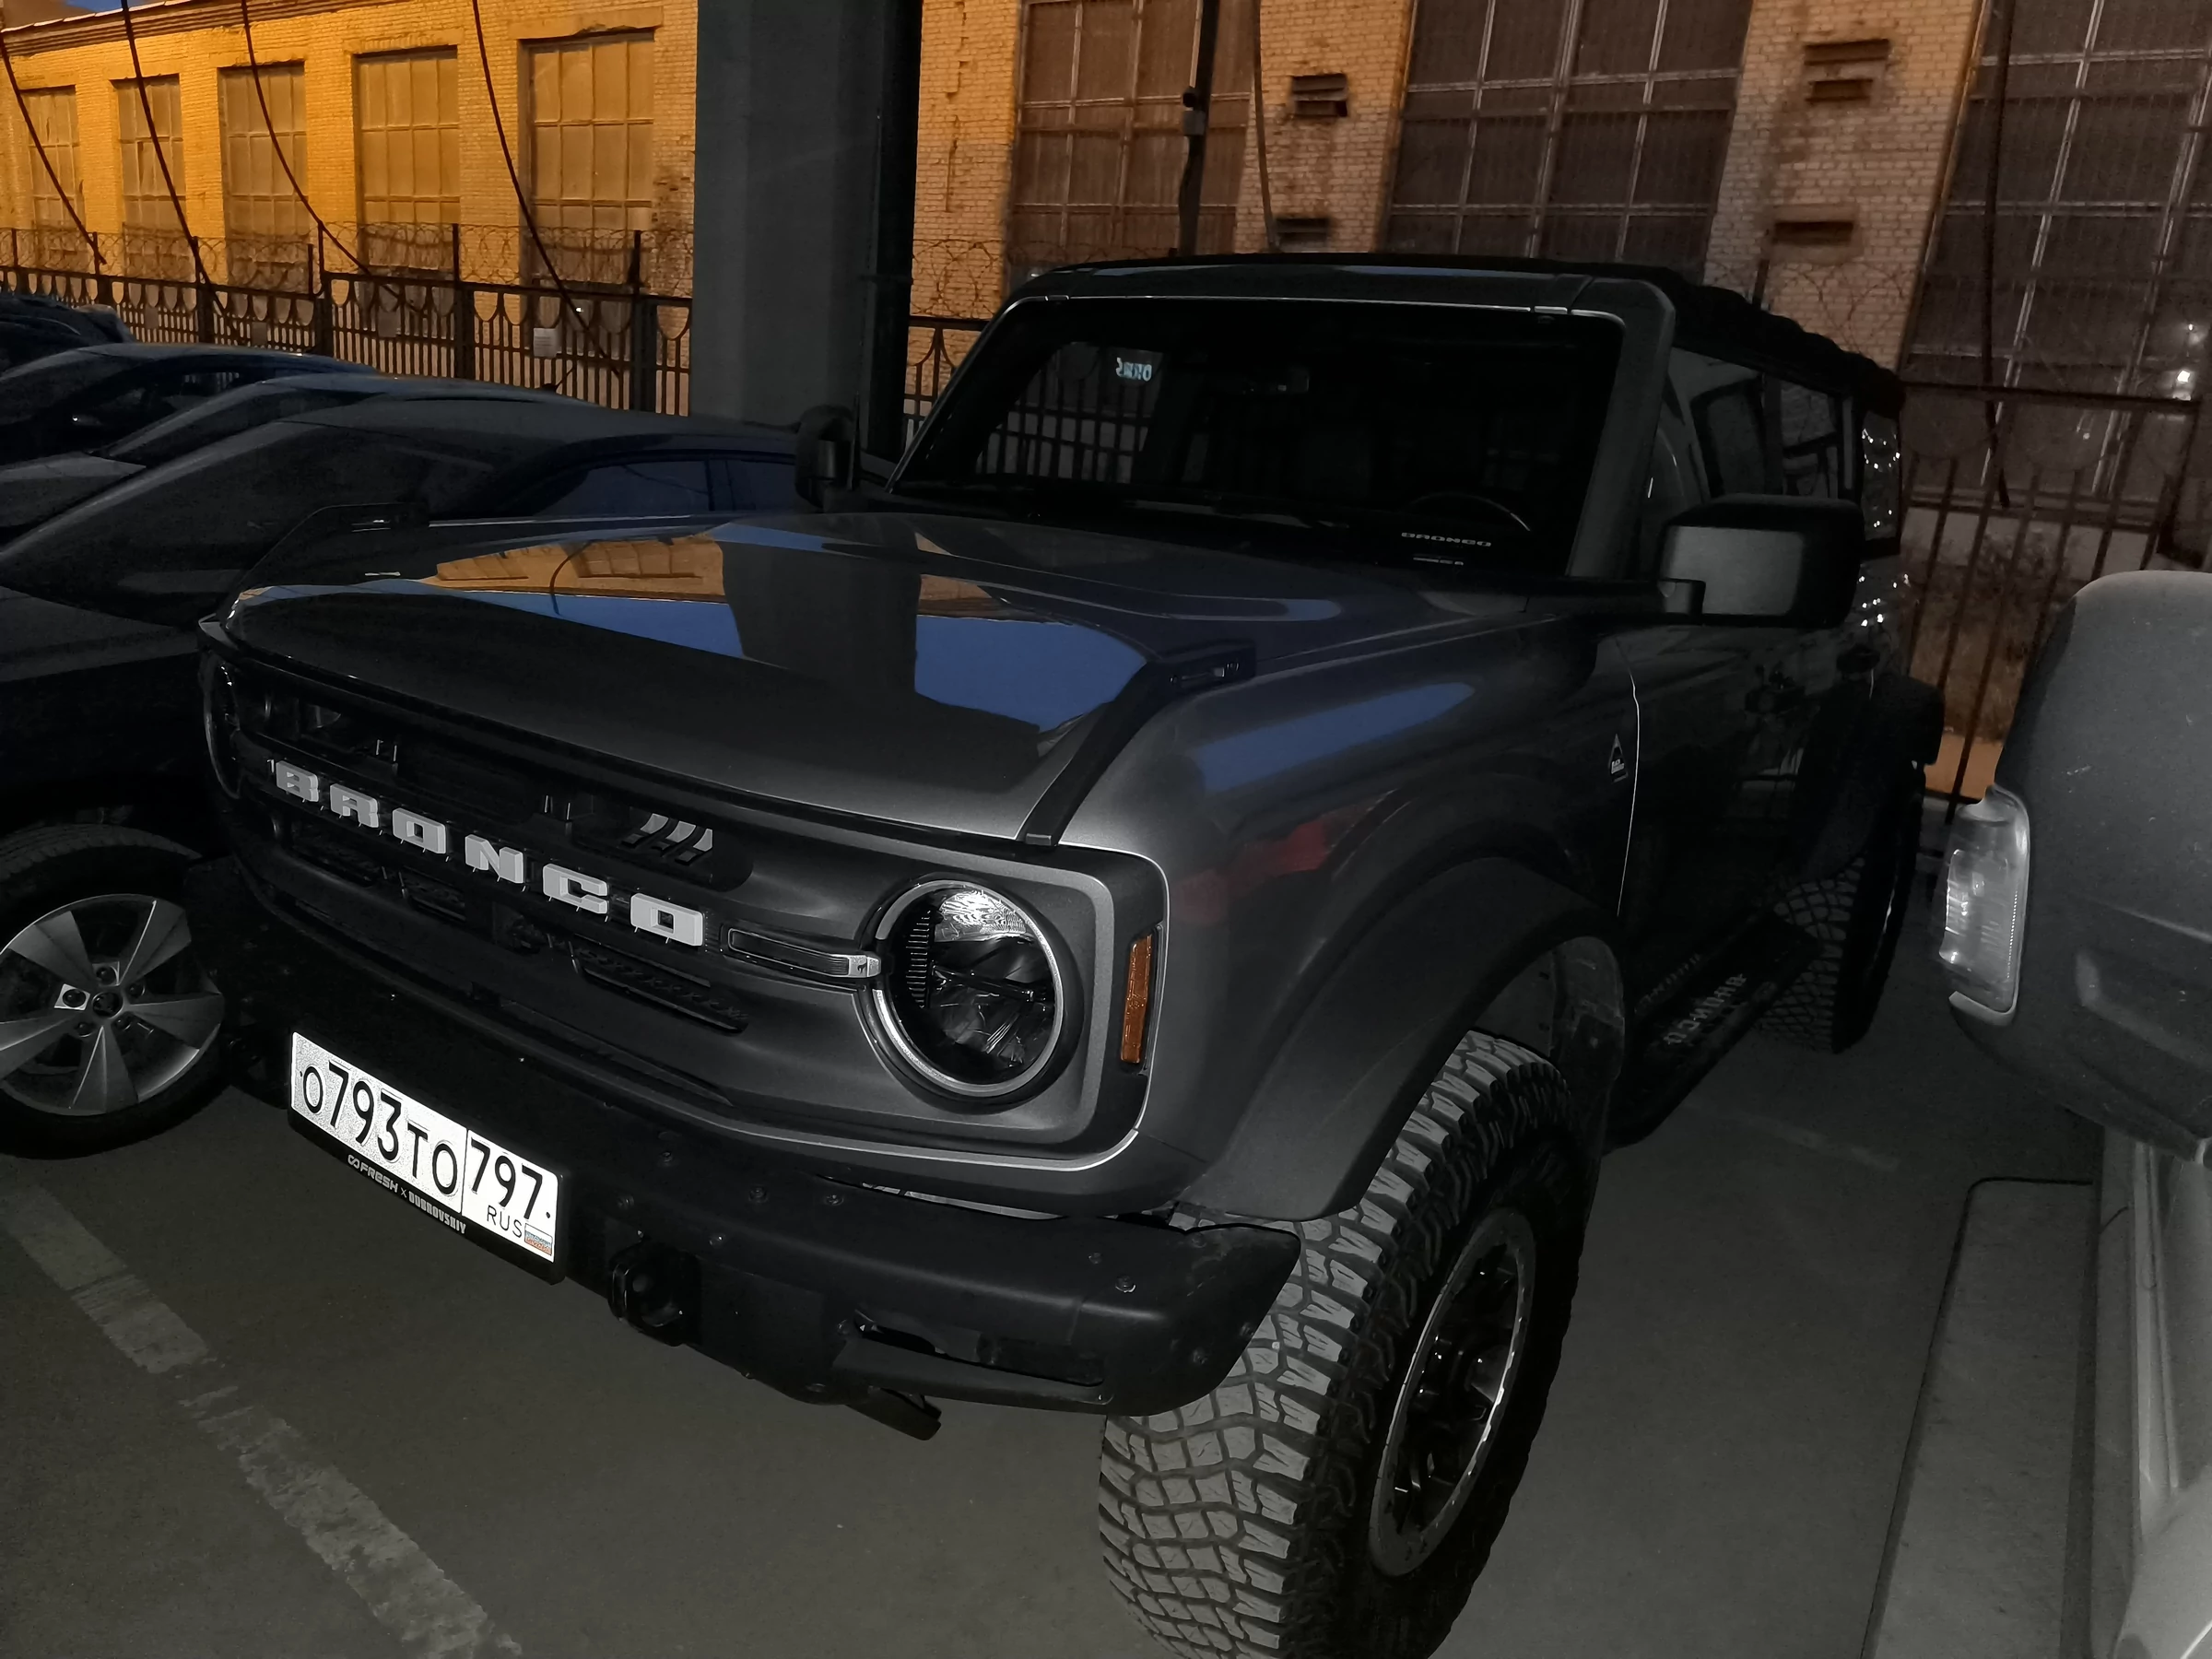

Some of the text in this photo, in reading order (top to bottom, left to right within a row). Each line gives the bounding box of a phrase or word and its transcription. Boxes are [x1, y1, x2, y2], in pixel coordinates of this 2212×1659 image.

[276, 759, 703, 947] BRONCO
[470, 1137, 543, 1219] 797
[487, 1206, 522, 1238] RUS
